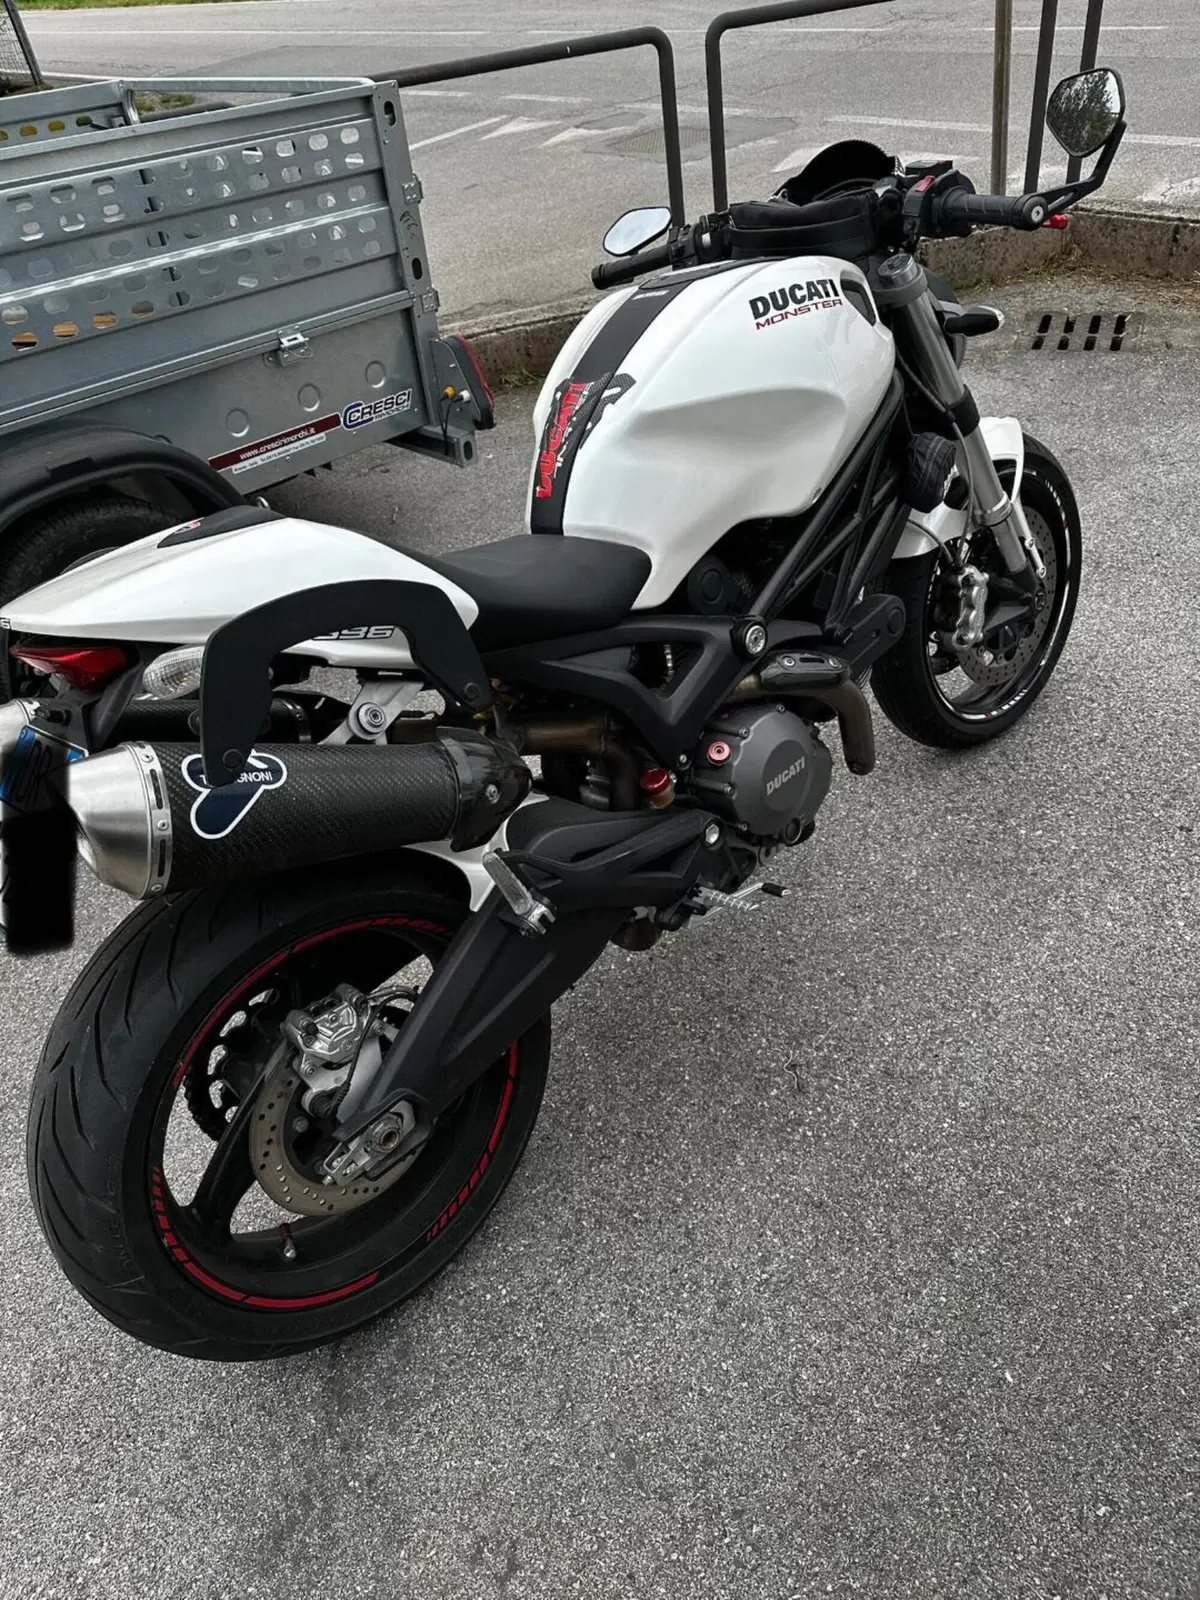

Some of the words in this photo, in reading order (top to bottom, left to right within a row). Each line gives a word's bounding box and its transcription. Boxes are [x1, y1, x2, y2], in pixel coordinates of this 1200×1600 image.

[749, 278, 840, 321] DUCATI
[755, 298, 843, 330] MONSTER
[343, 389, 411, 429] CRESCI
[765, 756, 806, 796] DUCATI
